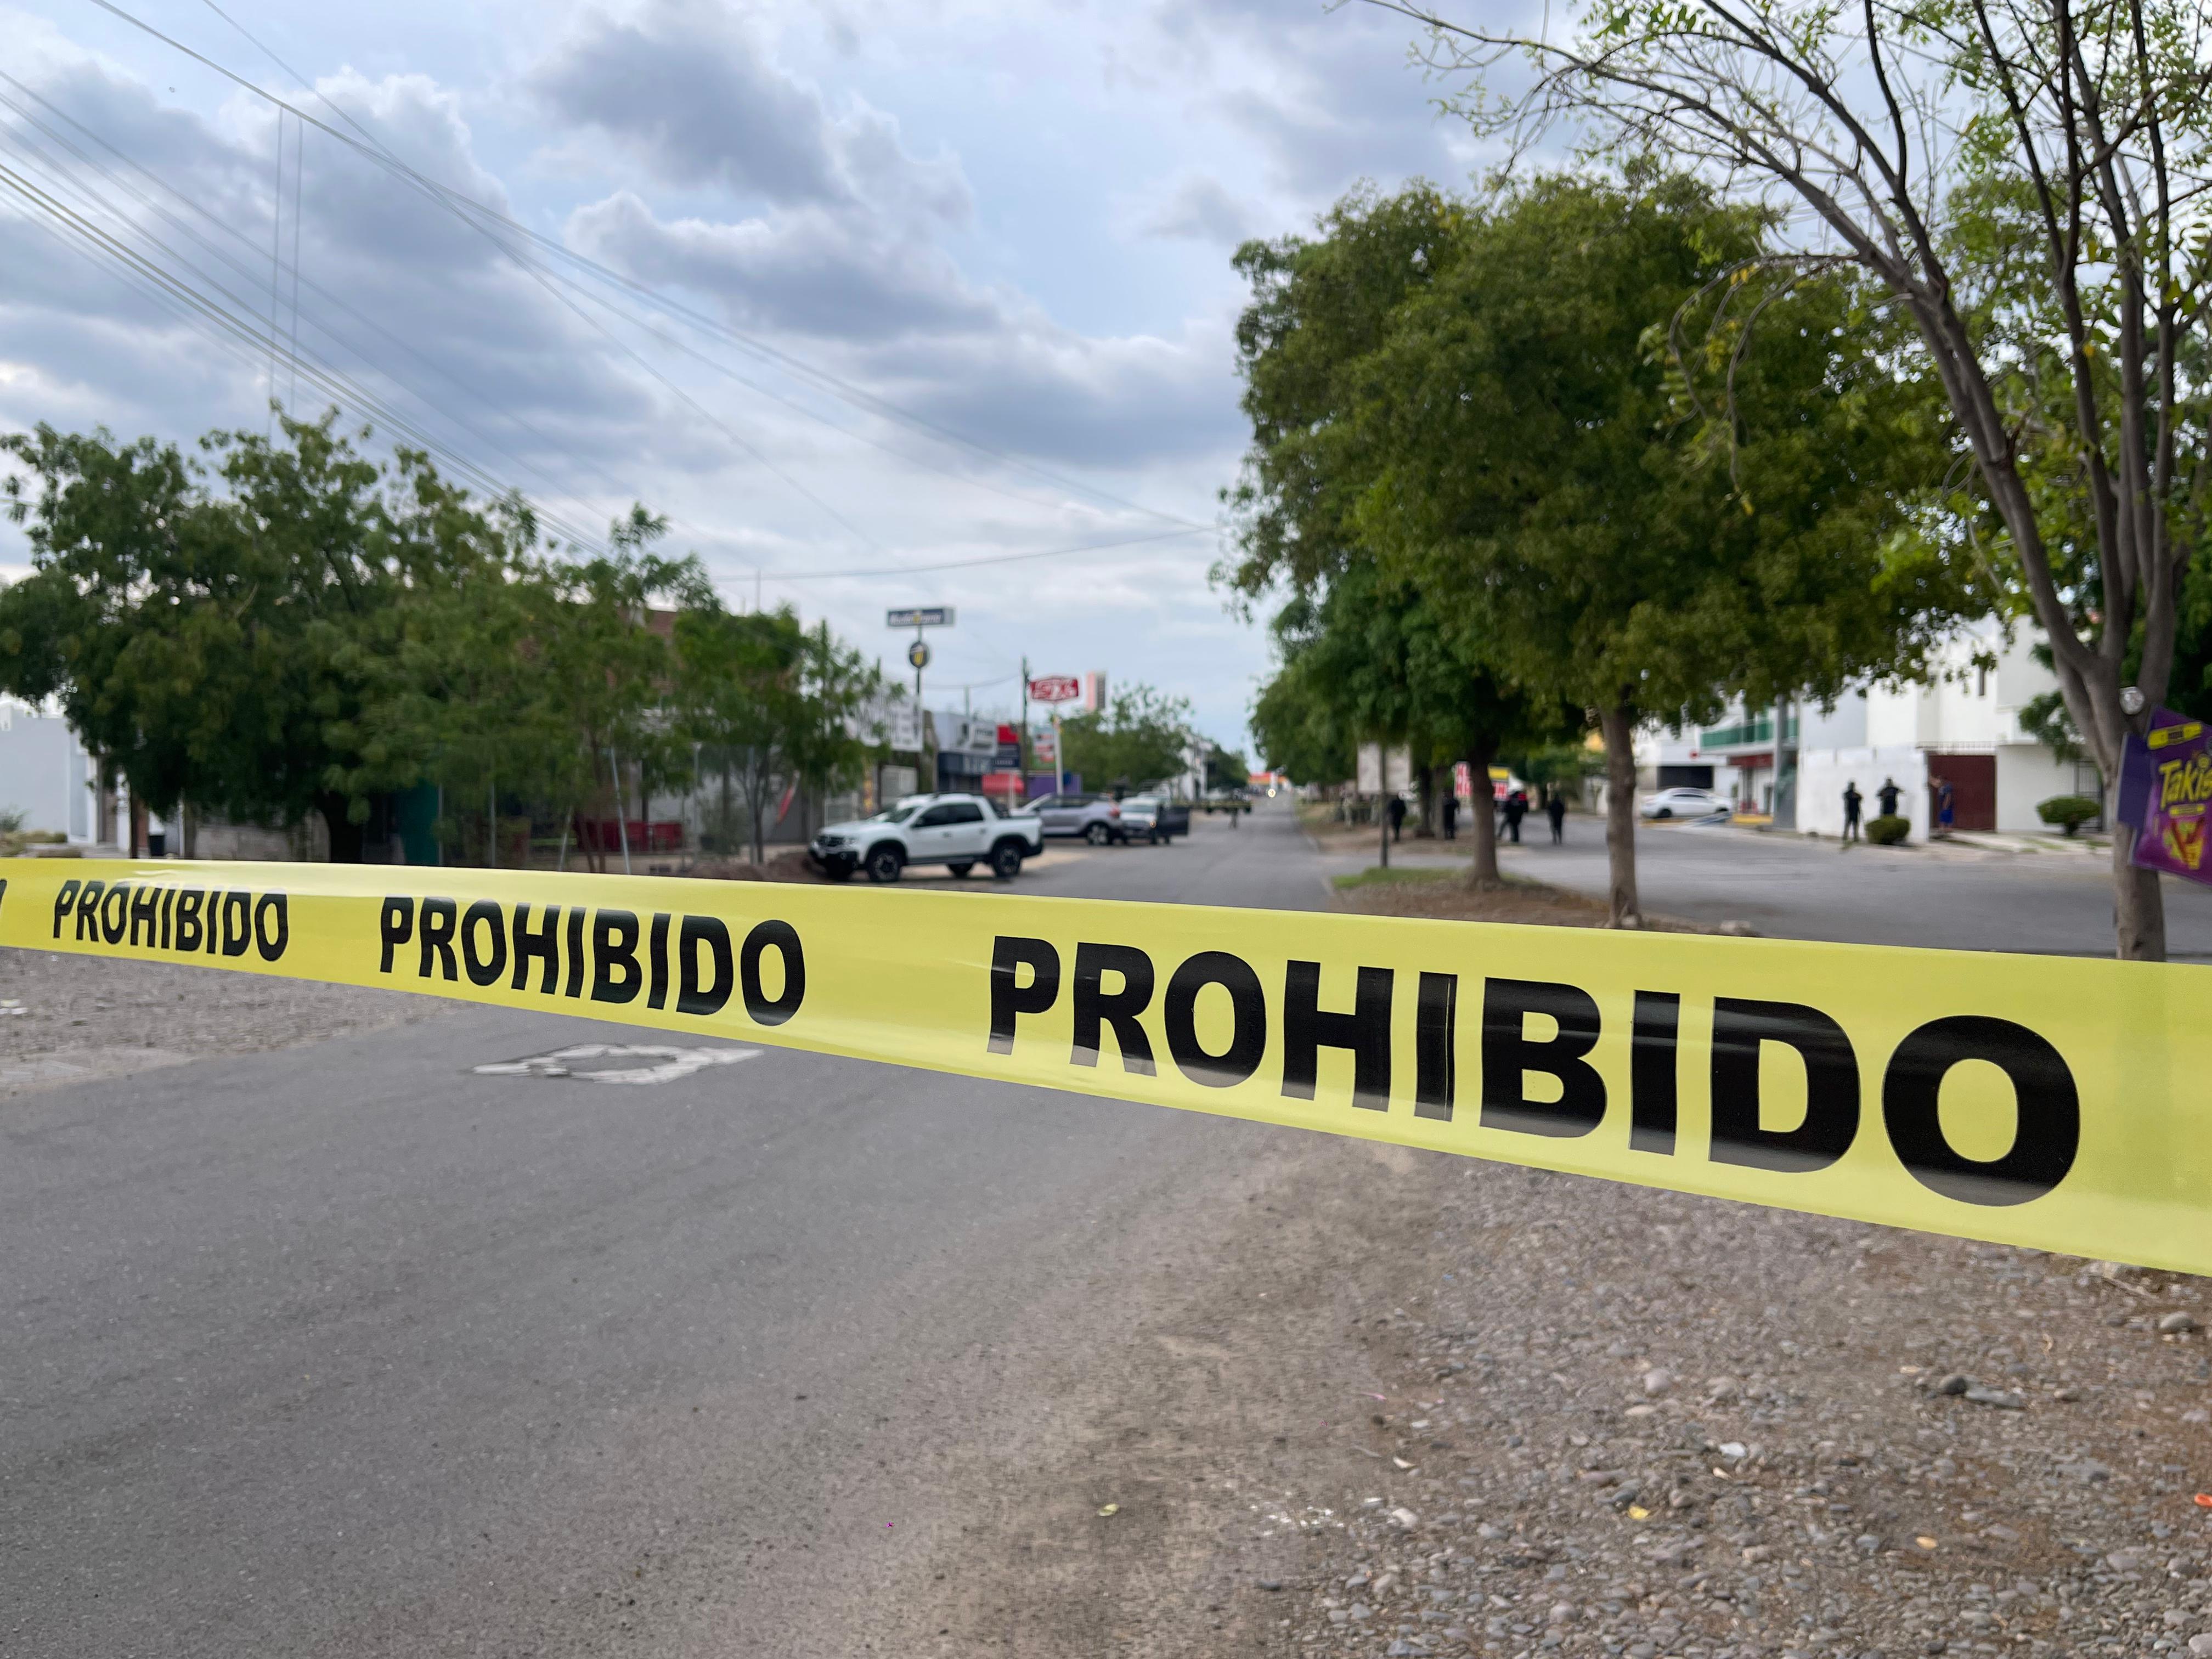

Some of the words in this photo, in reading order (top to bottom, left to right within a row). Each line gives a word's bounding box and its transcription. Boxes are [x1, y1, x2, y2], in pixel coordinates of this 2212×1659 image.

[53, 880, 289, 962] PROHIBIDO
[380, 894, 806, 1026] PROHIBIDO
[987, 936, 2081, 1206] PROHIBIDO
